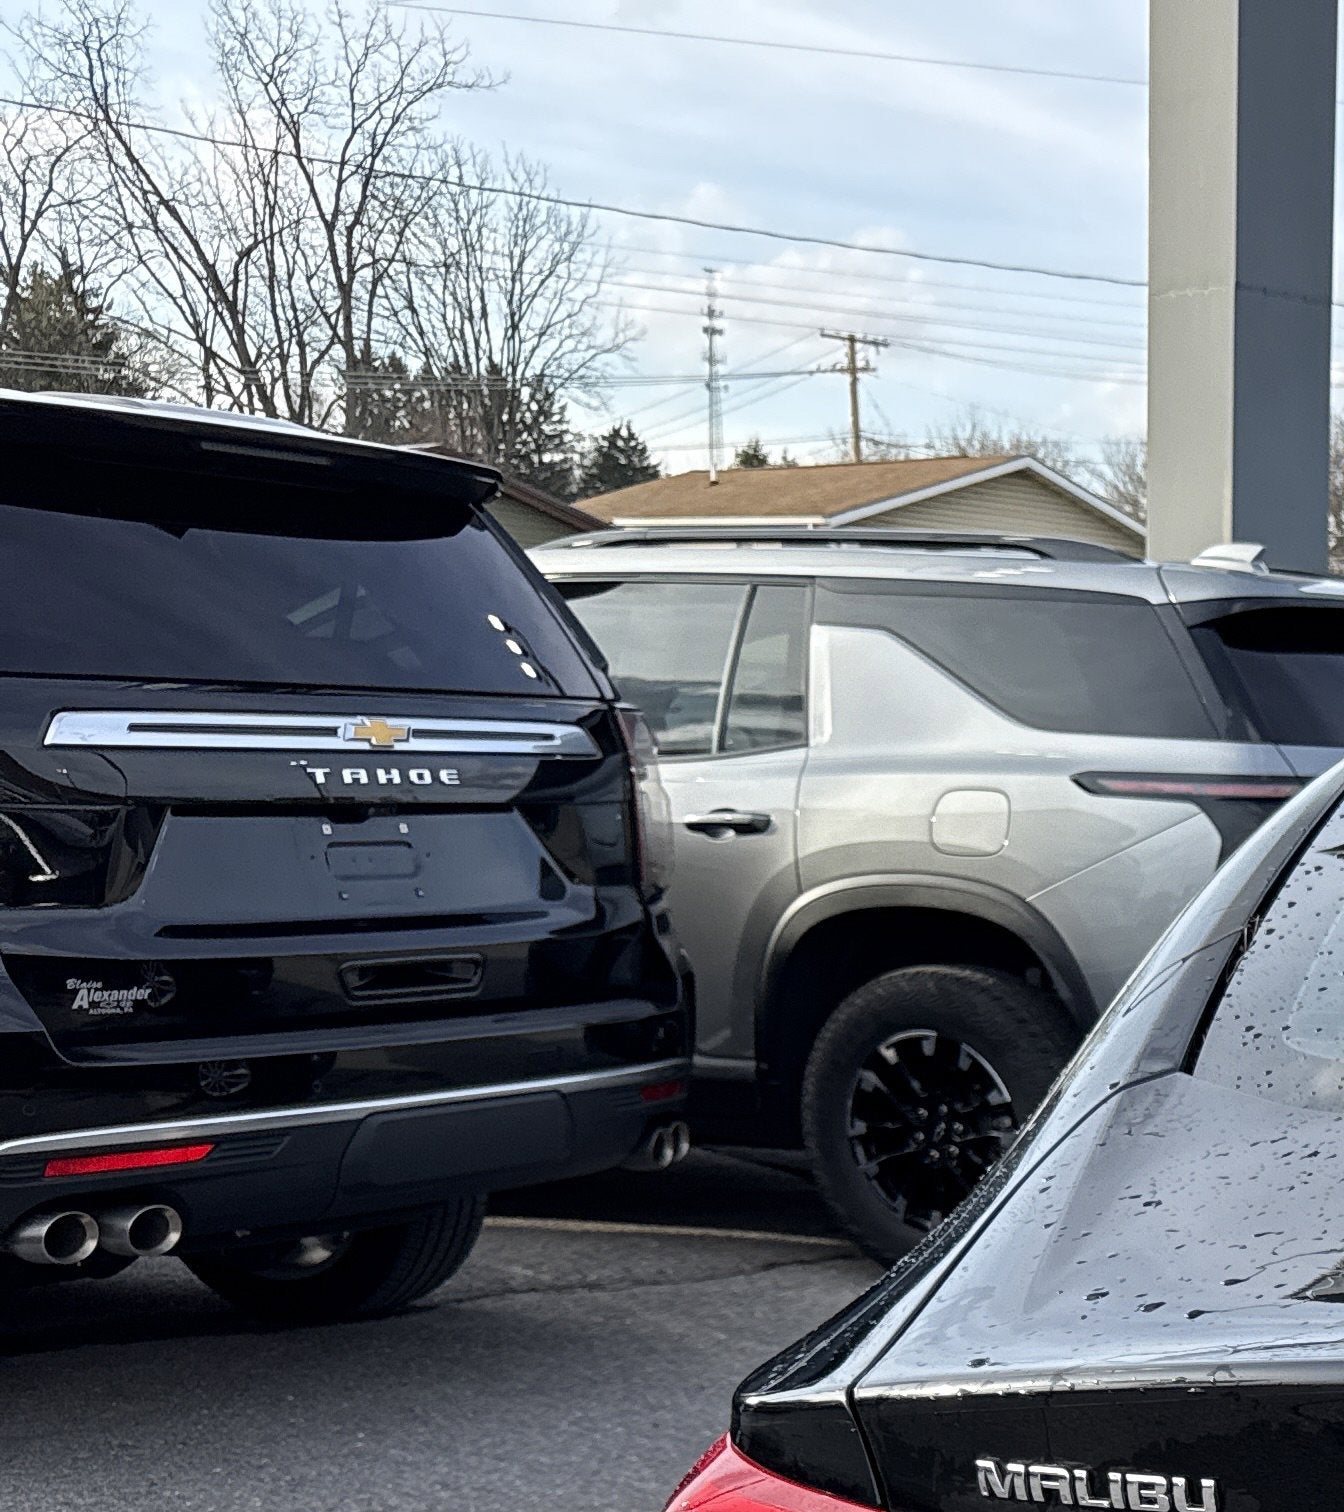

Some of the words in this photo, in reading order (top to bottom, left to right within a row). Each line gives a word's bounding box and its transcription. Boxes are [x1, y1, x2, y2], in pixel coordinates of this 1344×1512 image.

[306, 767, 461, 785] TAHOE
[66, 978, 103, 989] Blaise
[72, 986, 152, 1010] Alexander
